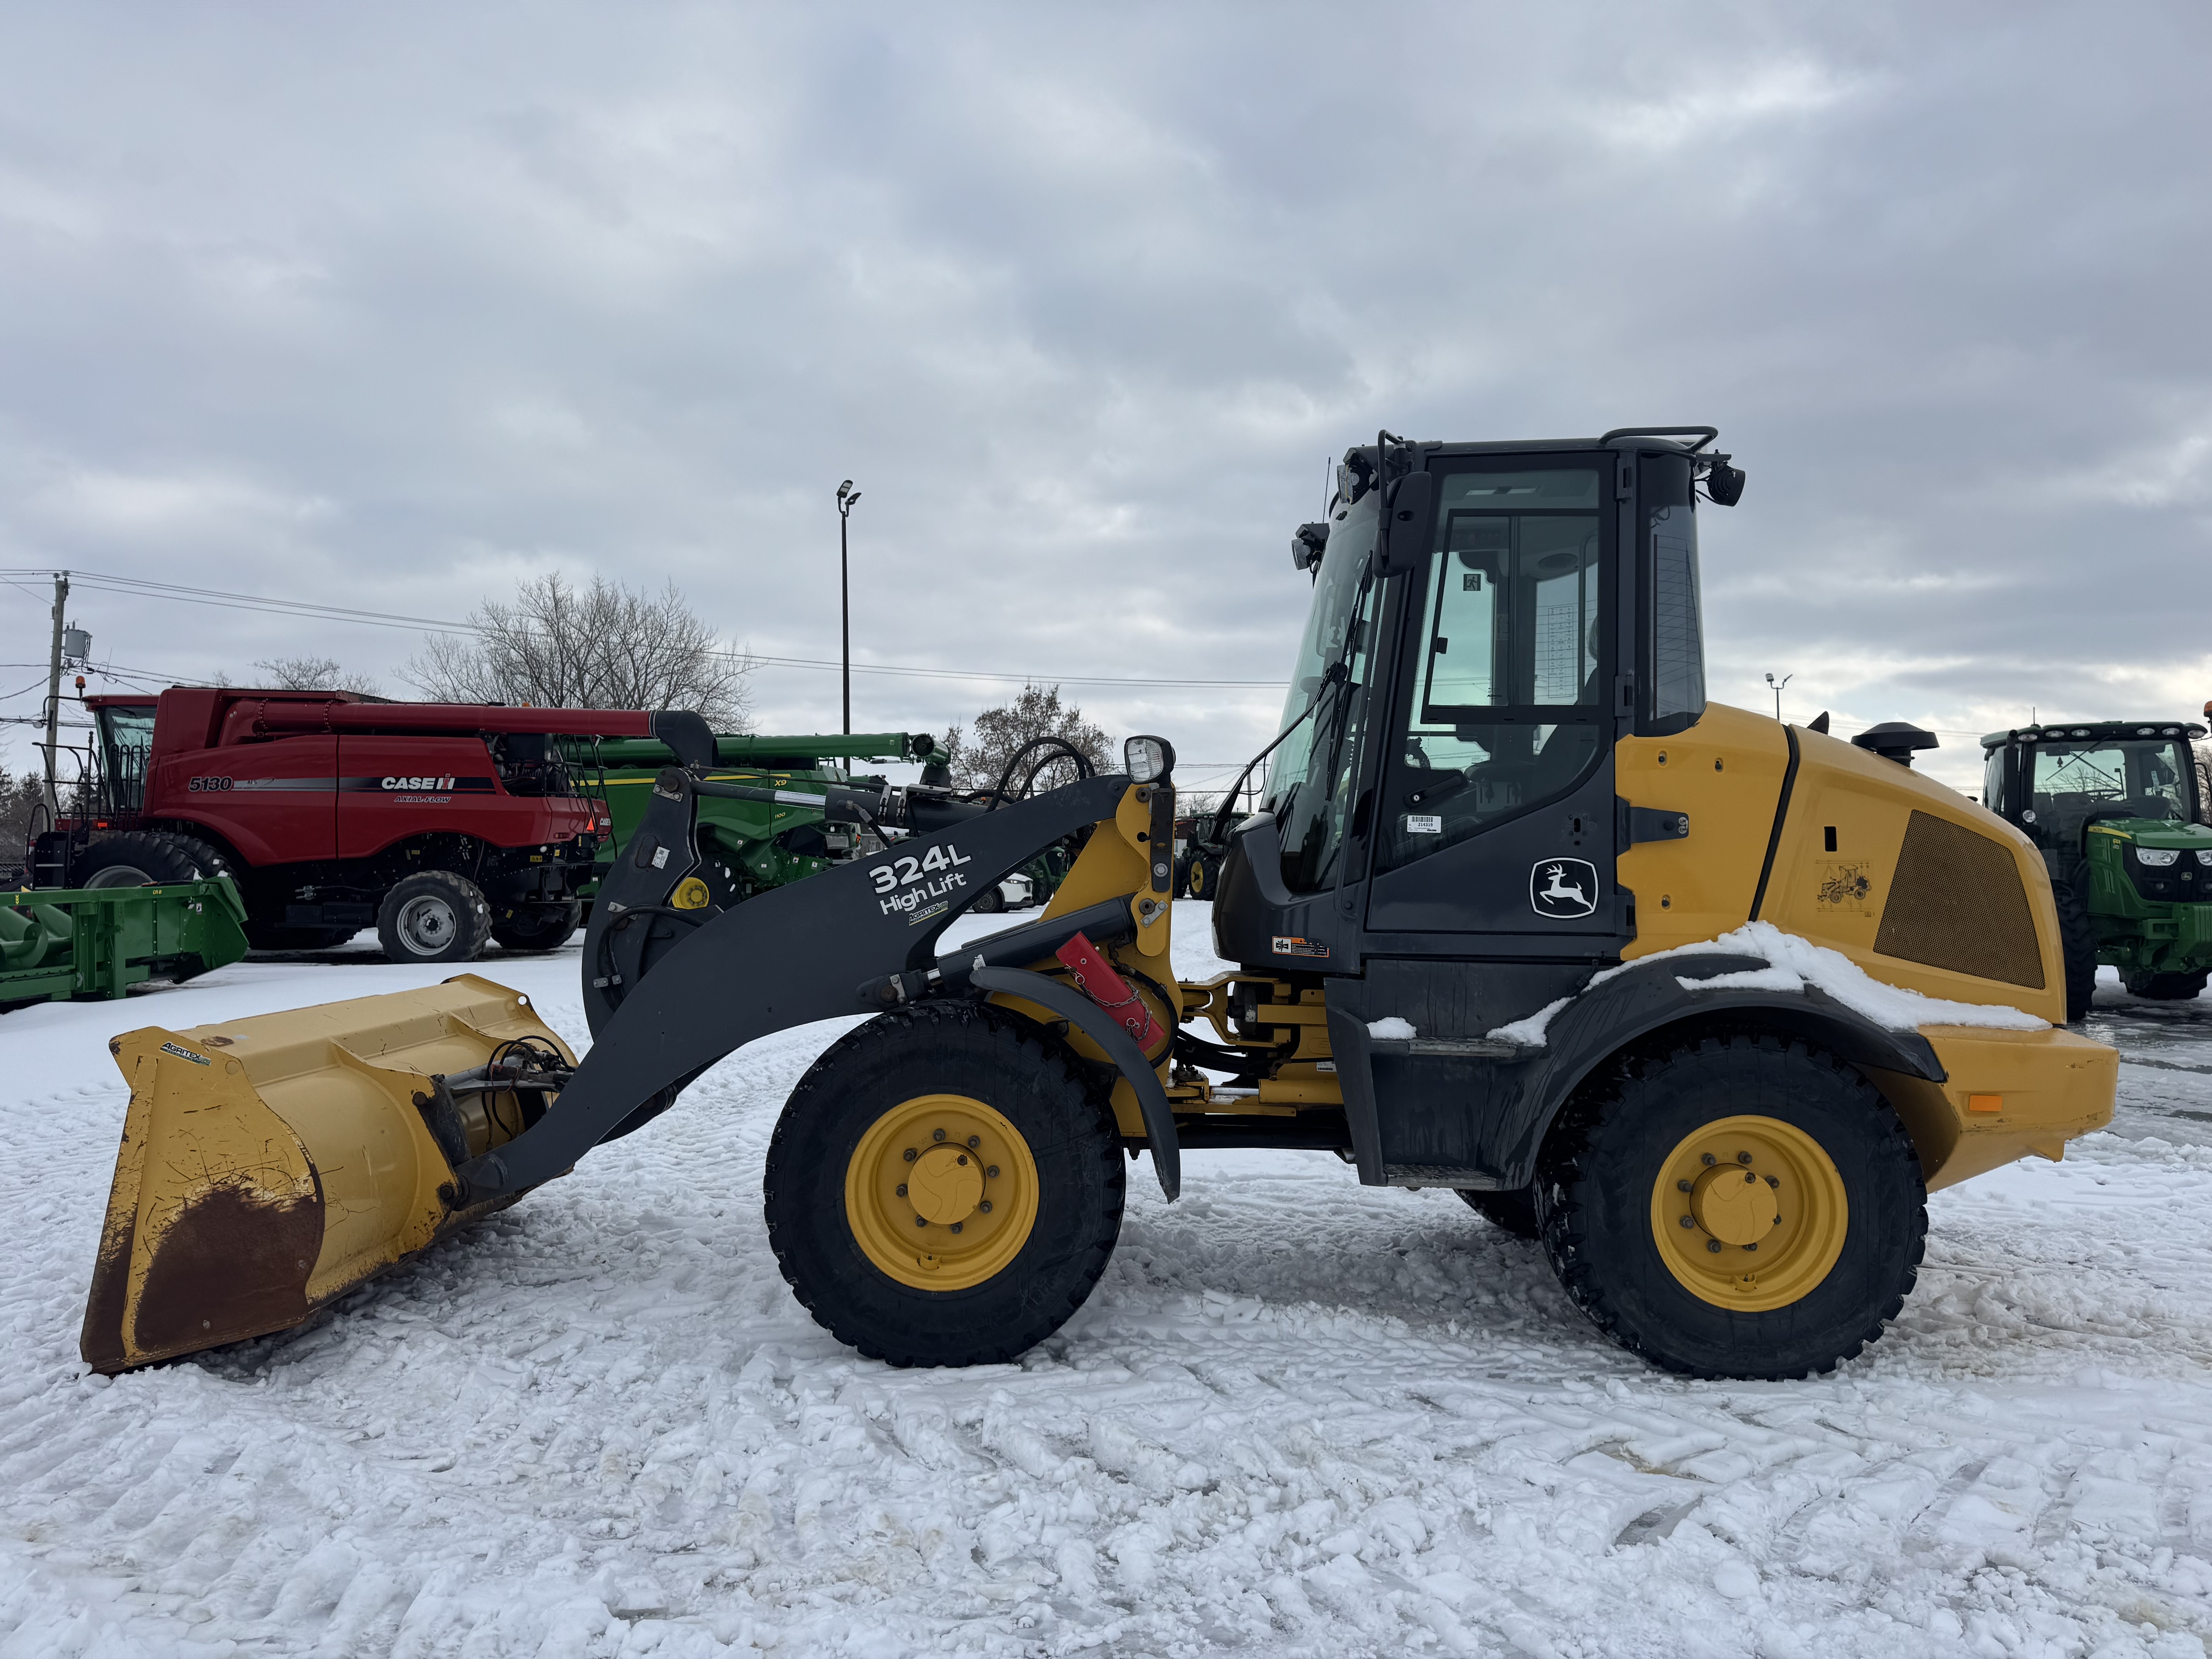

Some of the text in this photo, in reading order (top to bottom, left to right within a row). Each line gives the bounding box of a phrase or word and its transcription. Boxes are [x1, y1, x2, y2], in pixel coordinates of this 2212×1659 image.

[188, 776, 232, 792] 5130
[381, 777, 436, 790] CASE
[869, 844, 971, 893] 324L
[879, 872, 967, 915] High Lift
[910, 904, 940, 920] AGRITEX
[162, 1042, 201, 1060] AGRITEX
